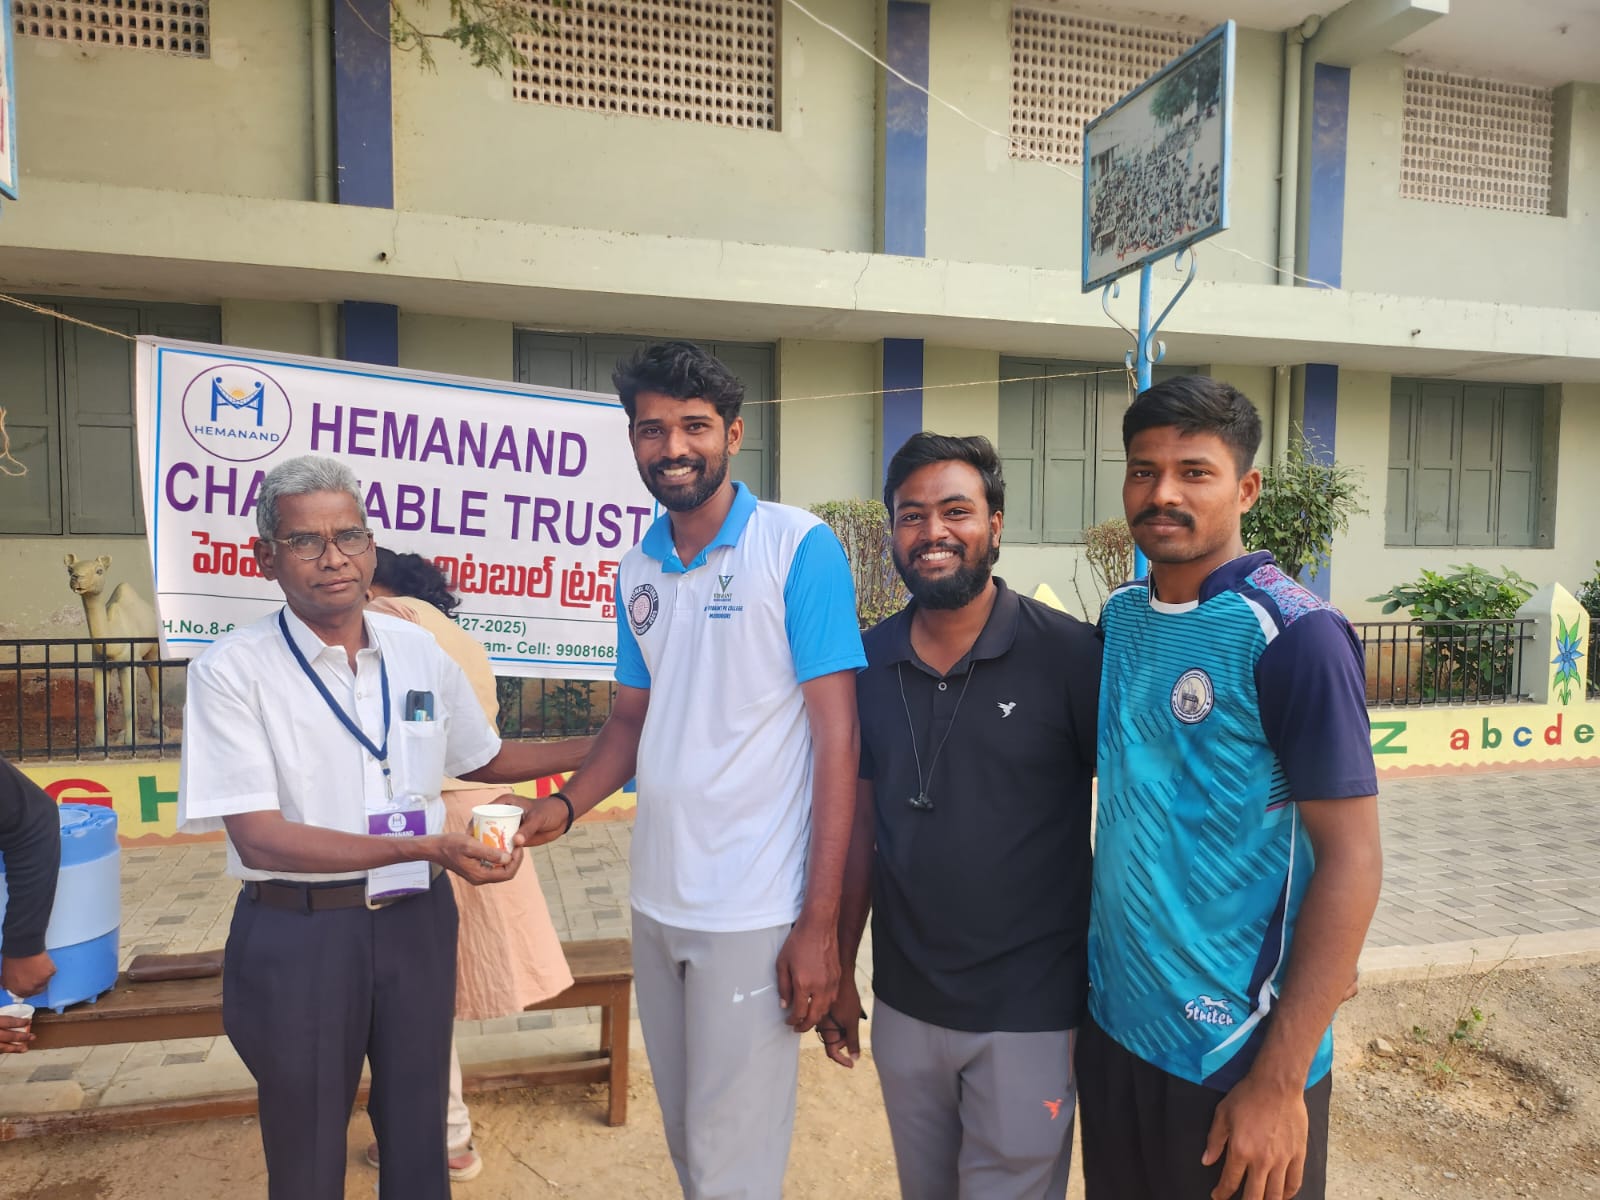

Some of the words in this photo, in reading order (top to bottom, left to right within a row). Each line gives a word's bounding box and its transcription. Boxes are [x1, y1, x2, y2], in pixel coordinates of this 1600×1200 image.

[194, 425, 280, 442] HEMANAND
[311, 402, 587, 477] HEMANAND
[165, 461, 488, 538] CHAABLE
[504, 494, 651, 549] TRUST
[517, 641, 551, 656] Cell:
